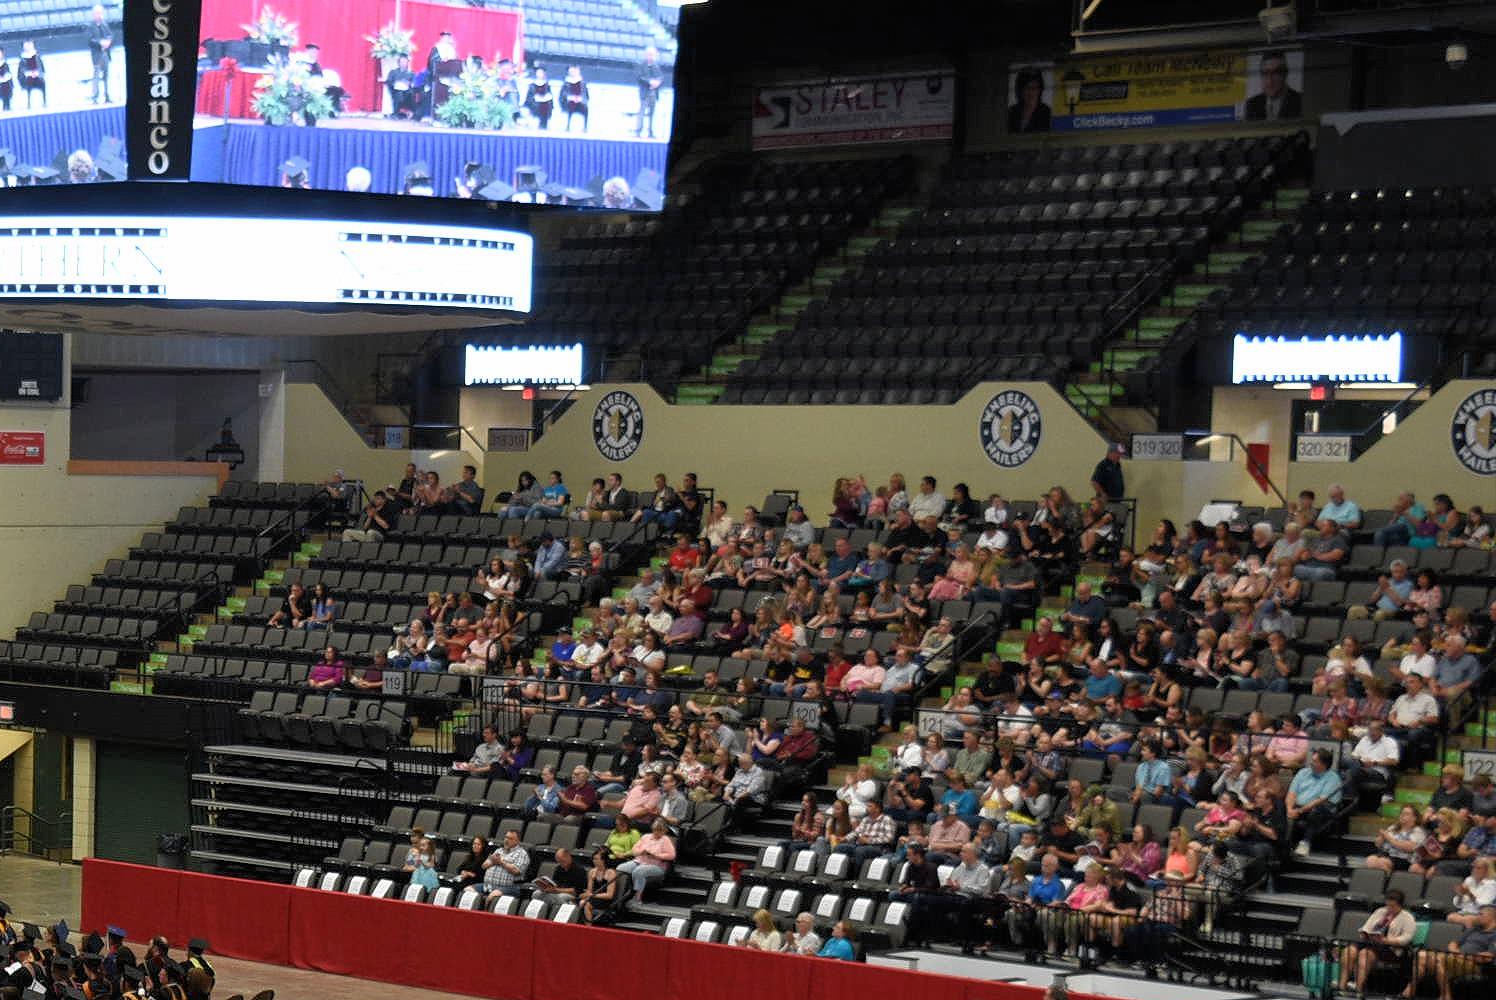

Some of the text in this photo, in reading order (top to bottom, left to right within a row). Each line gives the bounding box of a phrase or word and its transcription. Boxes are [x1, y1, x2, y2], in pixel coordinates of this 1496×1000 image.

[794, 79, 908, 115] STALEY
[595, 393, 641, 422] WHEELING
[982, 392, 1039, 424] WHEELING
[1454, 391, 1496, 424] WHEE
[598, 438, 638, 459] NAILERS
[985, 441, 1034, 465] NAILERS
[1134, 440, 1181, 456] 319 320
[1298, 442, 1349, 456] 320 321
[384, 677, 401, 690] 119
[795, 706, 816, 722] 120
[922, 717, 944, 732] 121
[1468, 759, 1494, 776] 122
